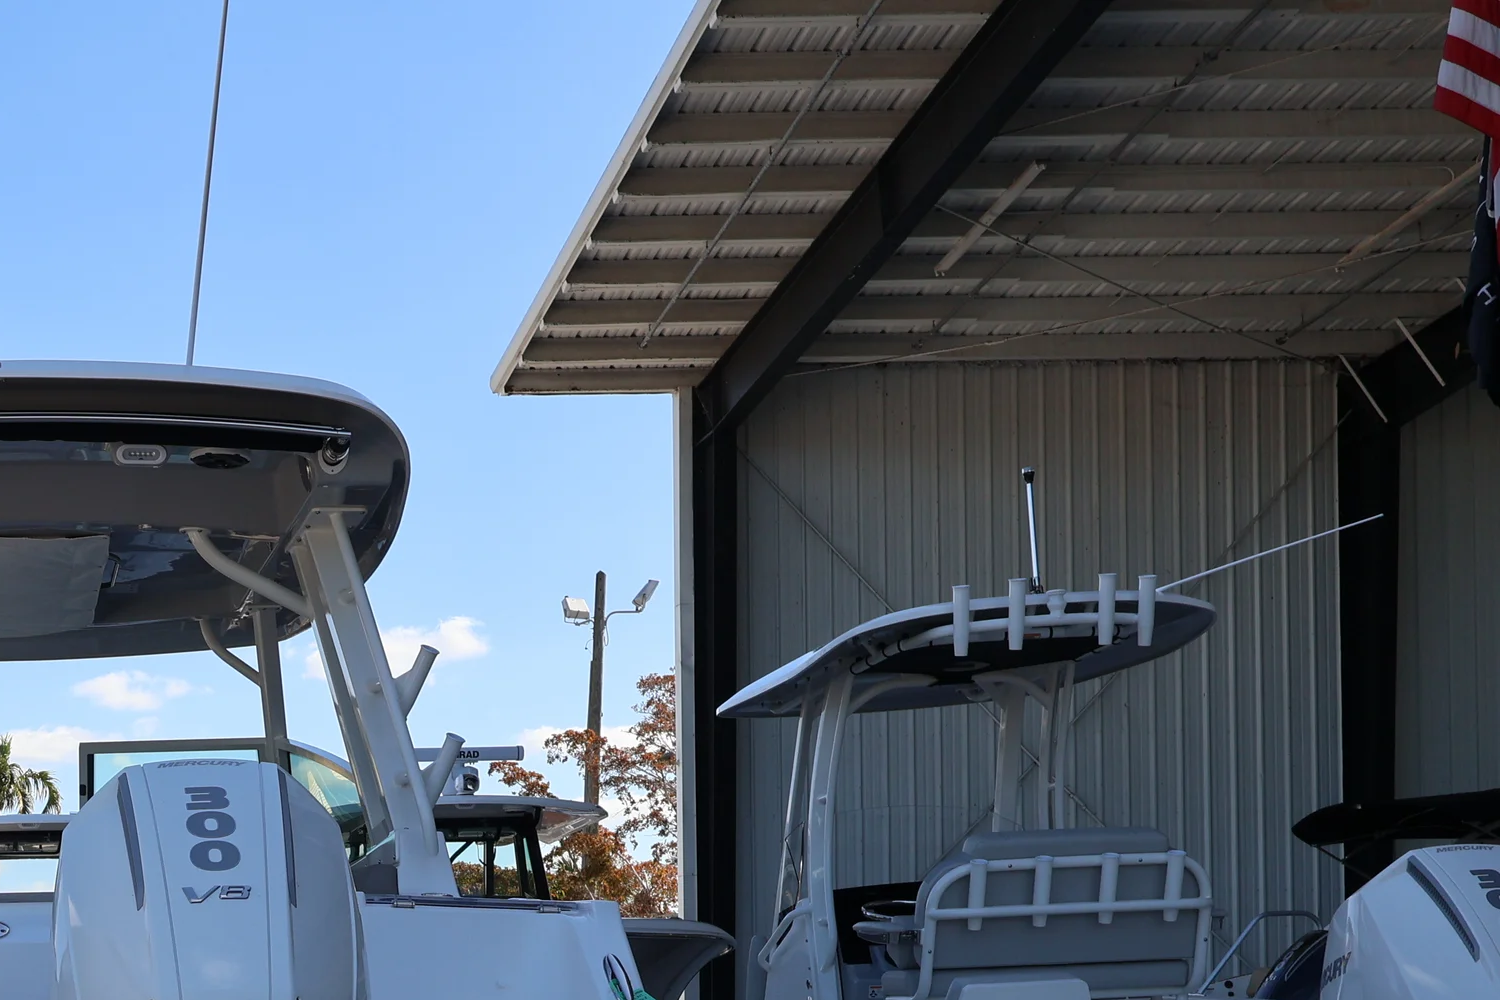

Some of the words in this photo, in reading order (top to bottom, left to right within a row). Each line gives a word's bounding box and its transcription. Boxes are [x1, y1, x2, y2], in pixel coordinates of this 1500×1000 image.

[457, 750, 480, 759] RAD
[156, 760, 246, 769] MERCURY
[184, 786, 242, 872] 300
[1436, 845, 1494, 853] MERCURY
[181, 885, 252, 904] V8
